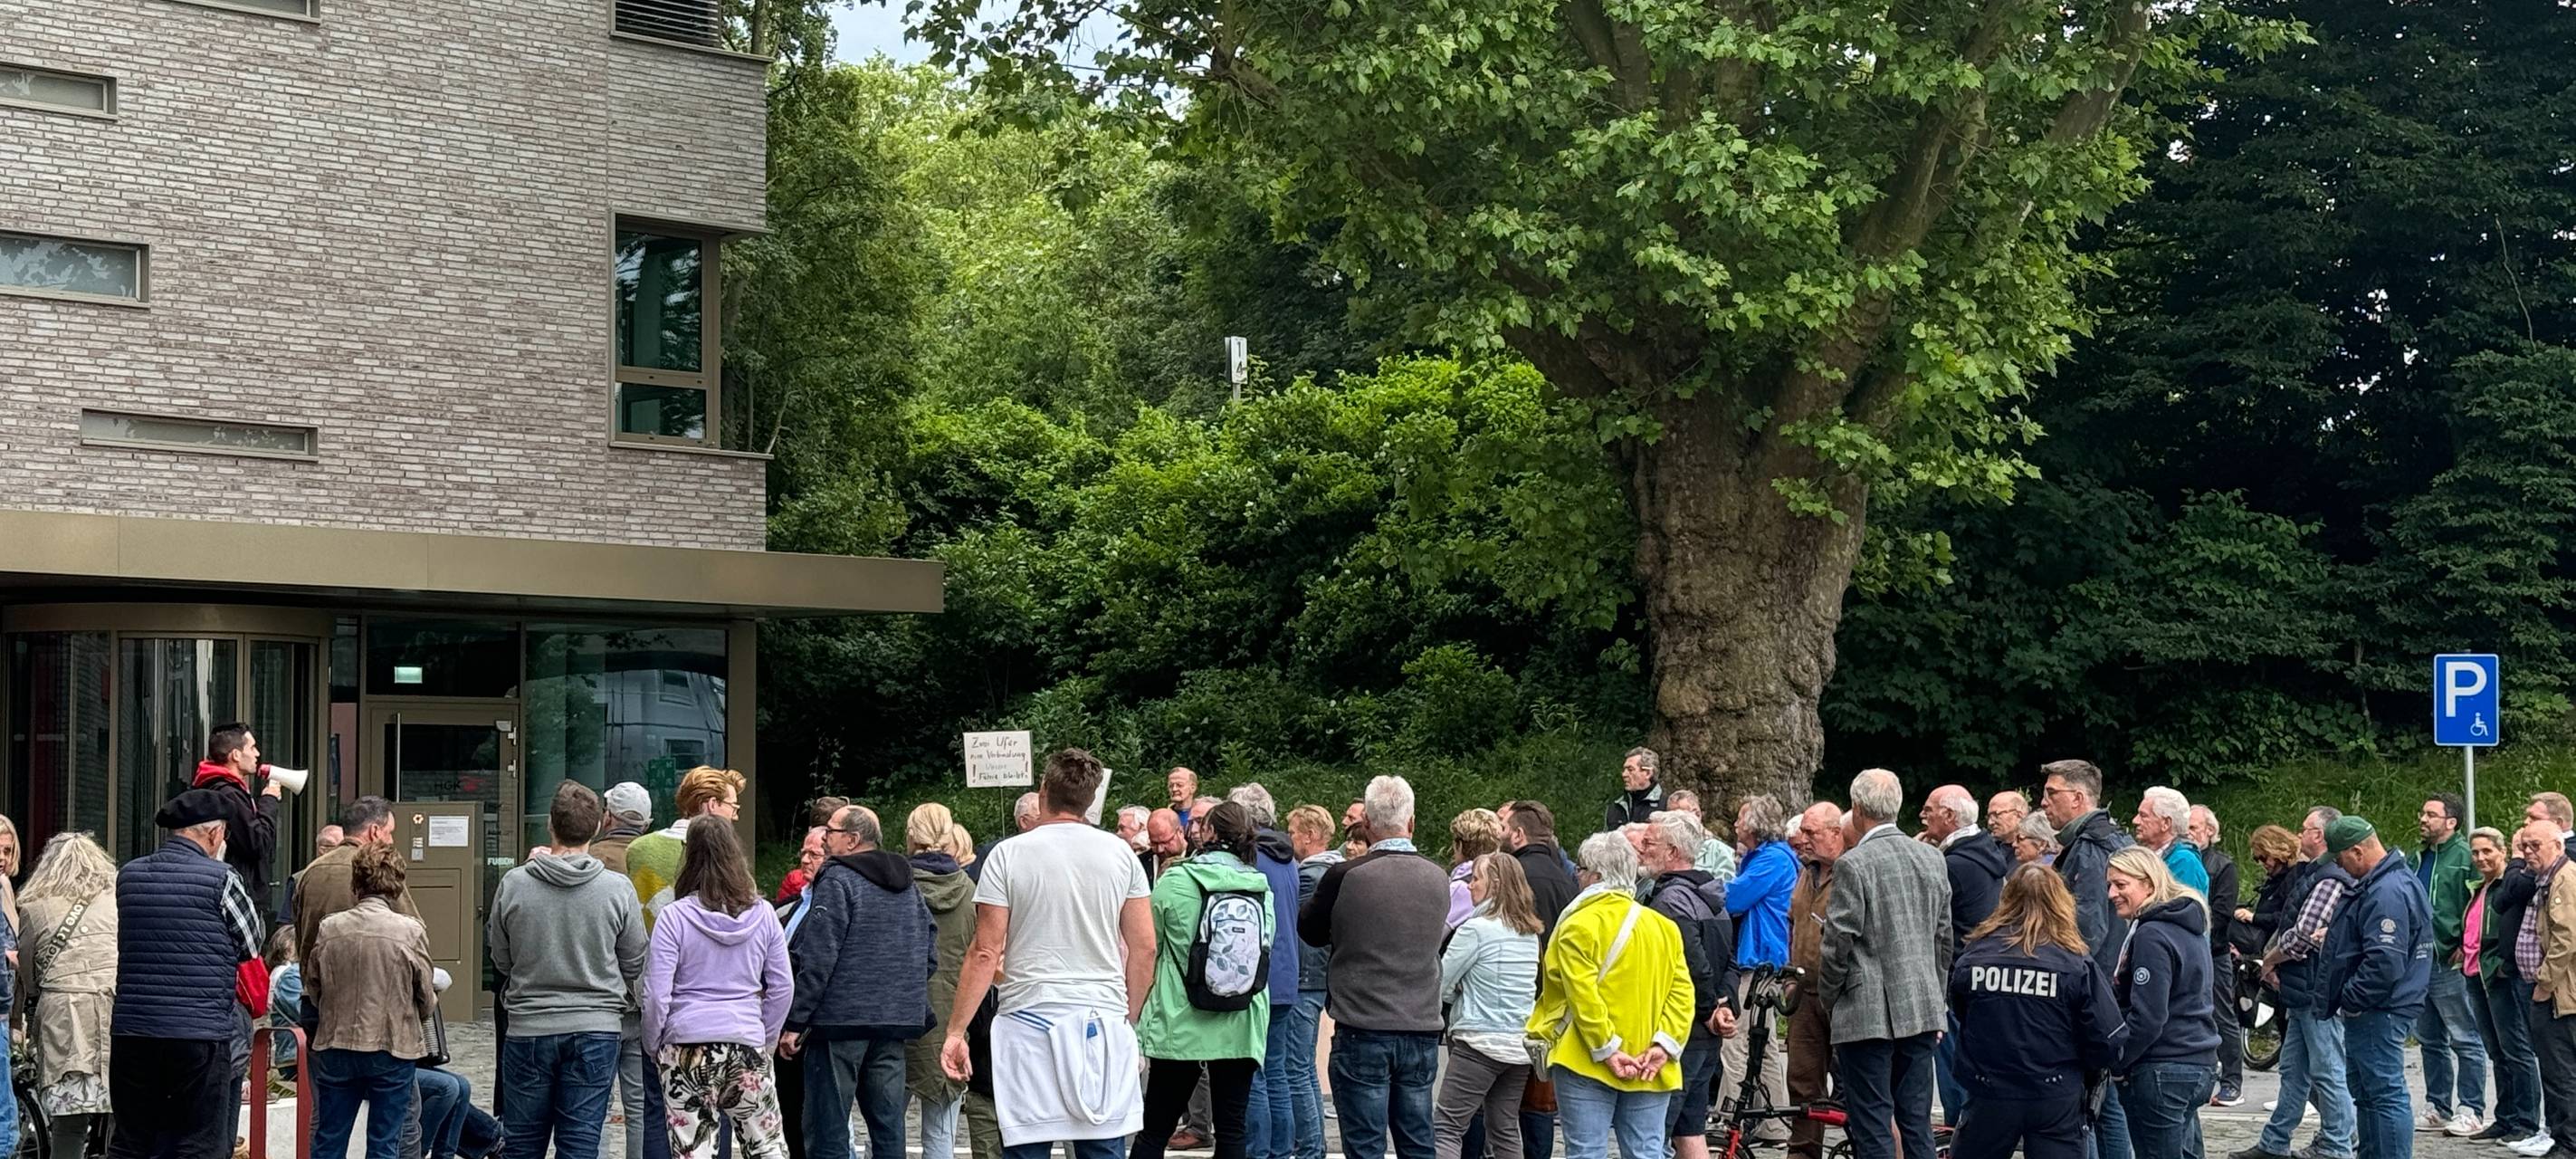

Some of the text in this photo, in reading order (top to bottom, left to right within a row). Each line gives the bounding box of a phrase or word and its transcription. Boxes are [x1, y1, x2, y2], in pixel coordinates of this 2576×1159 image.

[2446, 662, 2487, 717] P
[997, 736, 1017, 750] Ufer
[434, 780, 462, 790] HGK
[1970, 966, 2057, 997] POLIZEI
